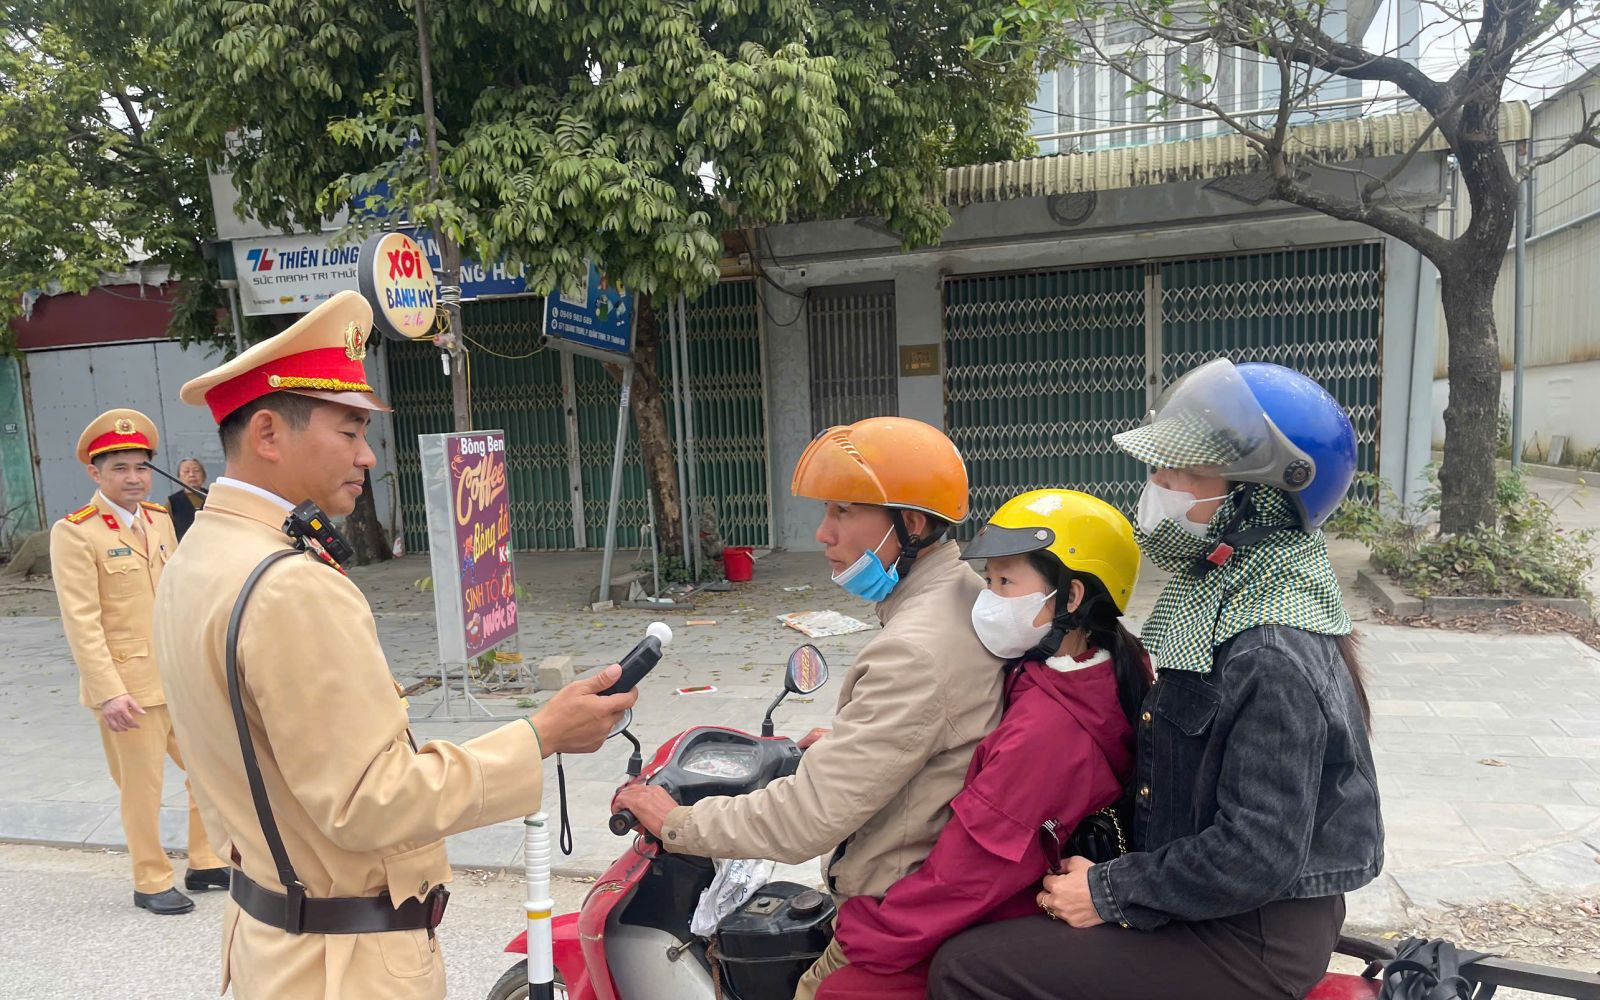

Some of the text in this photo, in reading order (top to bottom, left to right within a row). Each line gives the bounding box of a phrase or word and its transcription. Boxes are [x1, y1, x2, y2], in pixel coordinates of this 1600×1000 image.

[278, 247, 319, 270] THIÊN
[322, 246, 360, 269] LONG
[311, 270, 328, 282] TRI
[386, 280, 416, 310] BÁNH
[460, 435, 504, 456] Bông Ben
[456, 454, 506, 526] Coffee
[473, 504, 508, 563] Bóng đá
[499, 545, 510, 563] K+
[466, 568, 500, 613] SINH TỐ
[483, 602, 506, 638] NƯỚC
